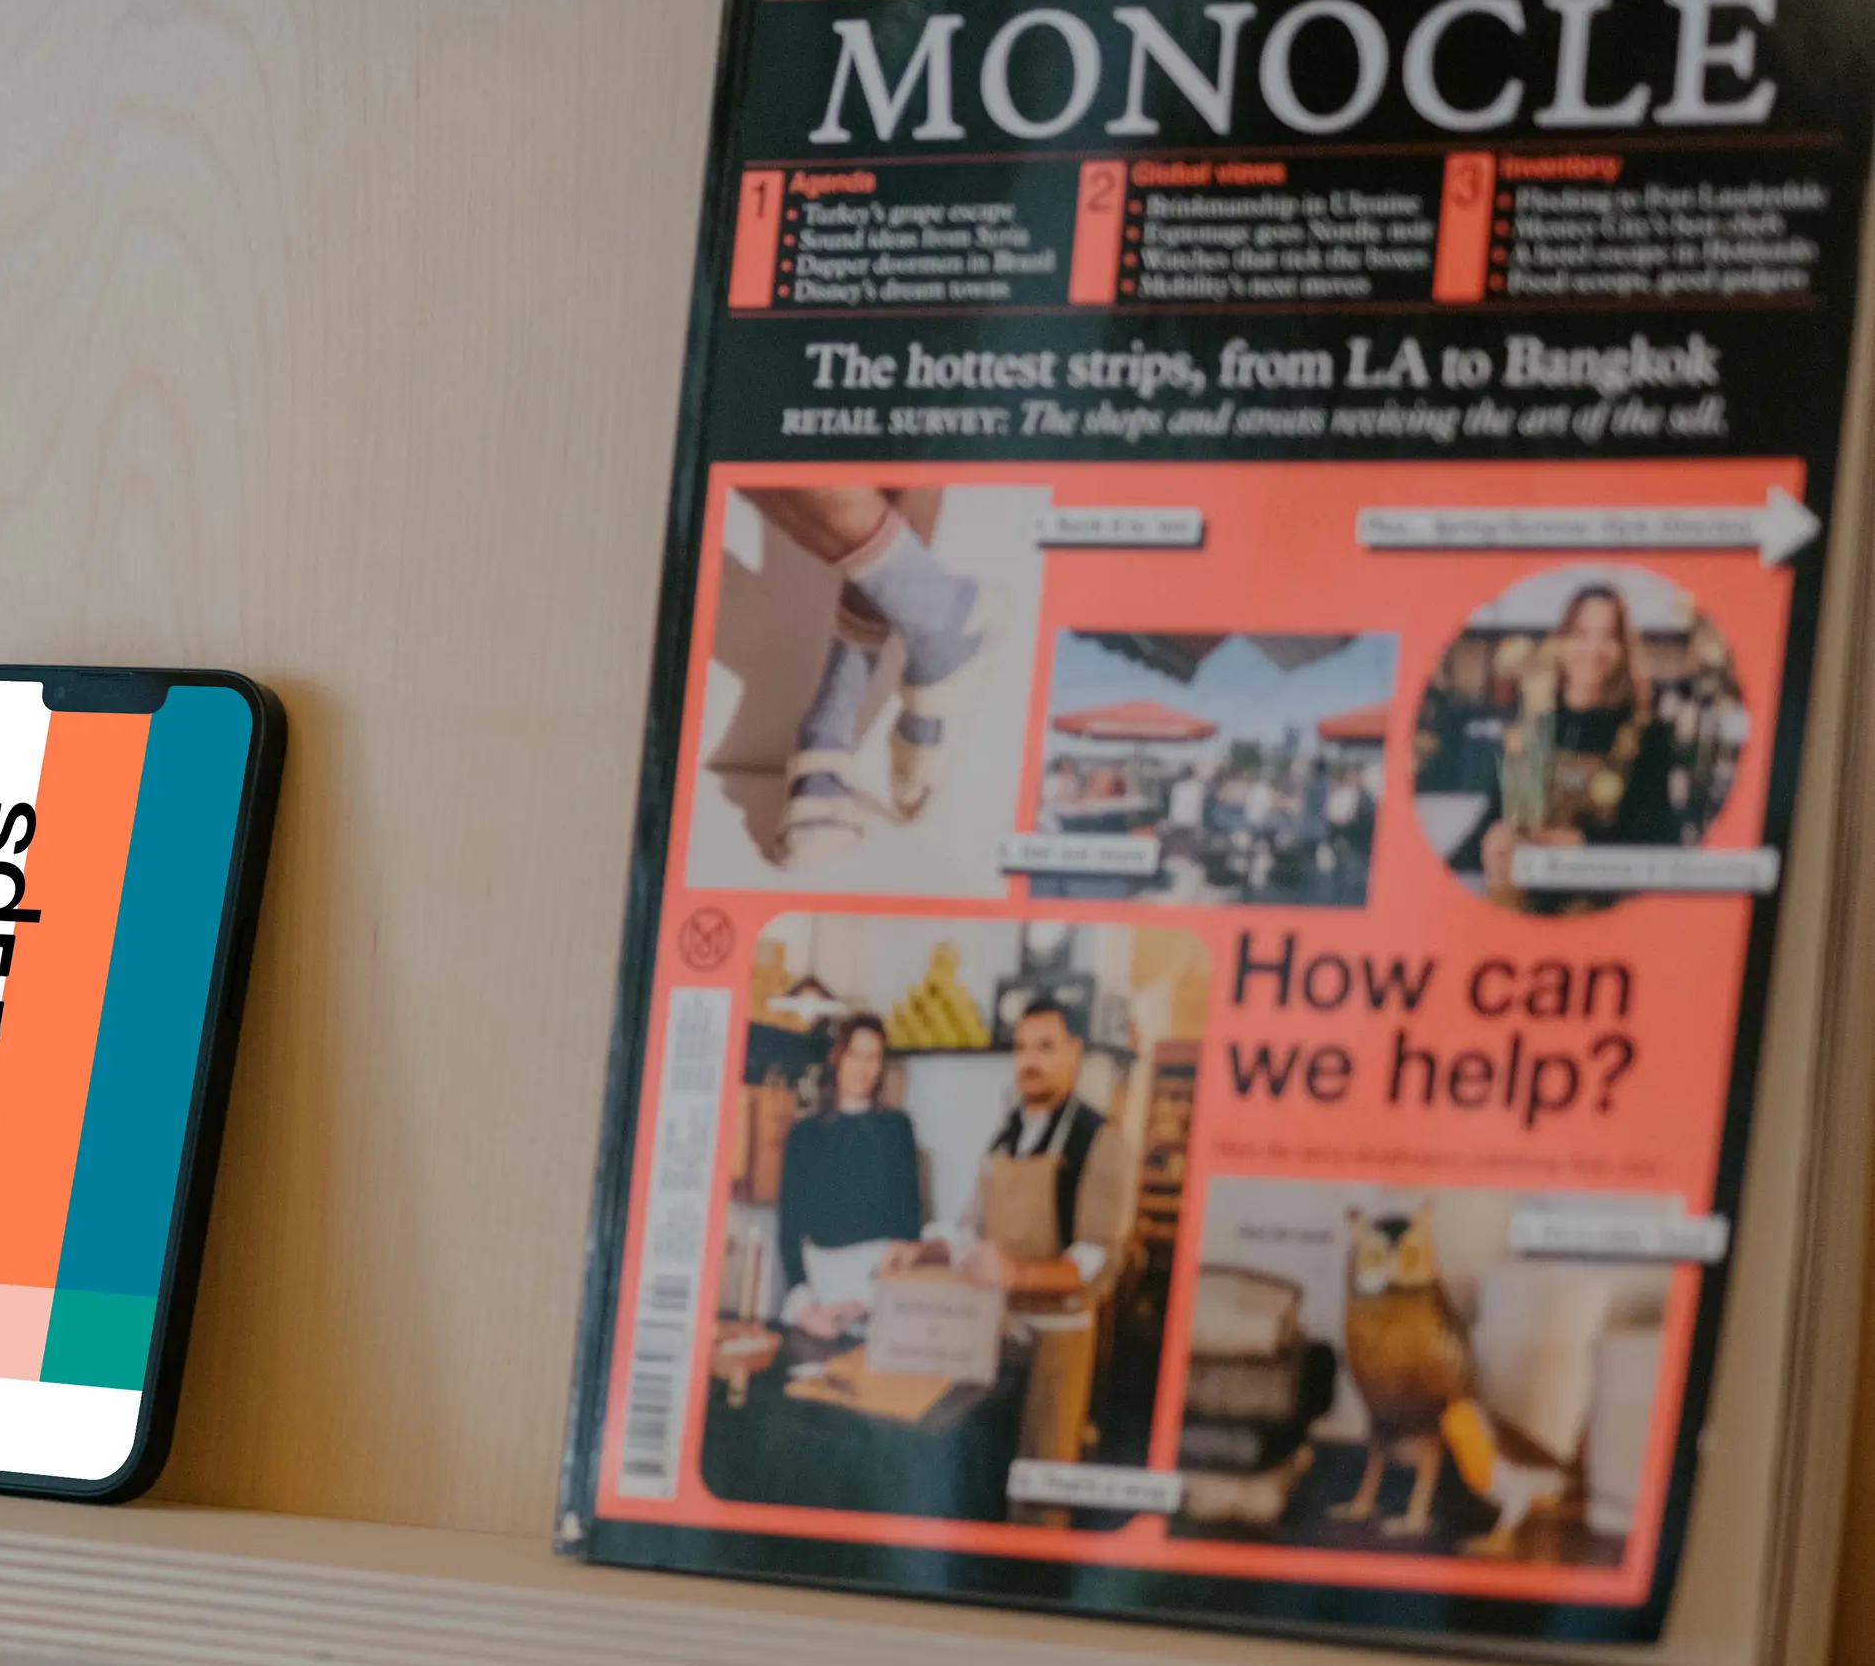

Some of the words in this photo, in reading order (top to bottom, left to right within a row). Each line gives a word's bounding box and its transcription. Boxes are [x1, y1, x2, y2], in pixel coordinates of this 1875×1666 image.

[752, 180, 768, 220] 1
[788, 171, 878, 199] Agenda
[1086, 169, 1116, 213] 2
[804, 340, 898, 390] The
[906, 340, 1057, 390] hottest
[1066, 337, 1207, 400] strips,
[1218, 337, 1334, 389] from
[1344, 335, 1431, 389] LA
[1440, 344, 1493, 388] to
[1502, 331, 1722, 398] Bangkok
[781, 405, 884, 437] RETAIL
[888, 405, 1010, 437] SURVEY:
[1020, 399, 1080, 437] The
[1082, 398, 1164, 443] shops
[1231, 930, 1434, 1011] How
[1467, 955, 1635, 1020] can
[1228, 1042, 1353, 1105] we
[1386, 1027, 1636, 1131] help?
